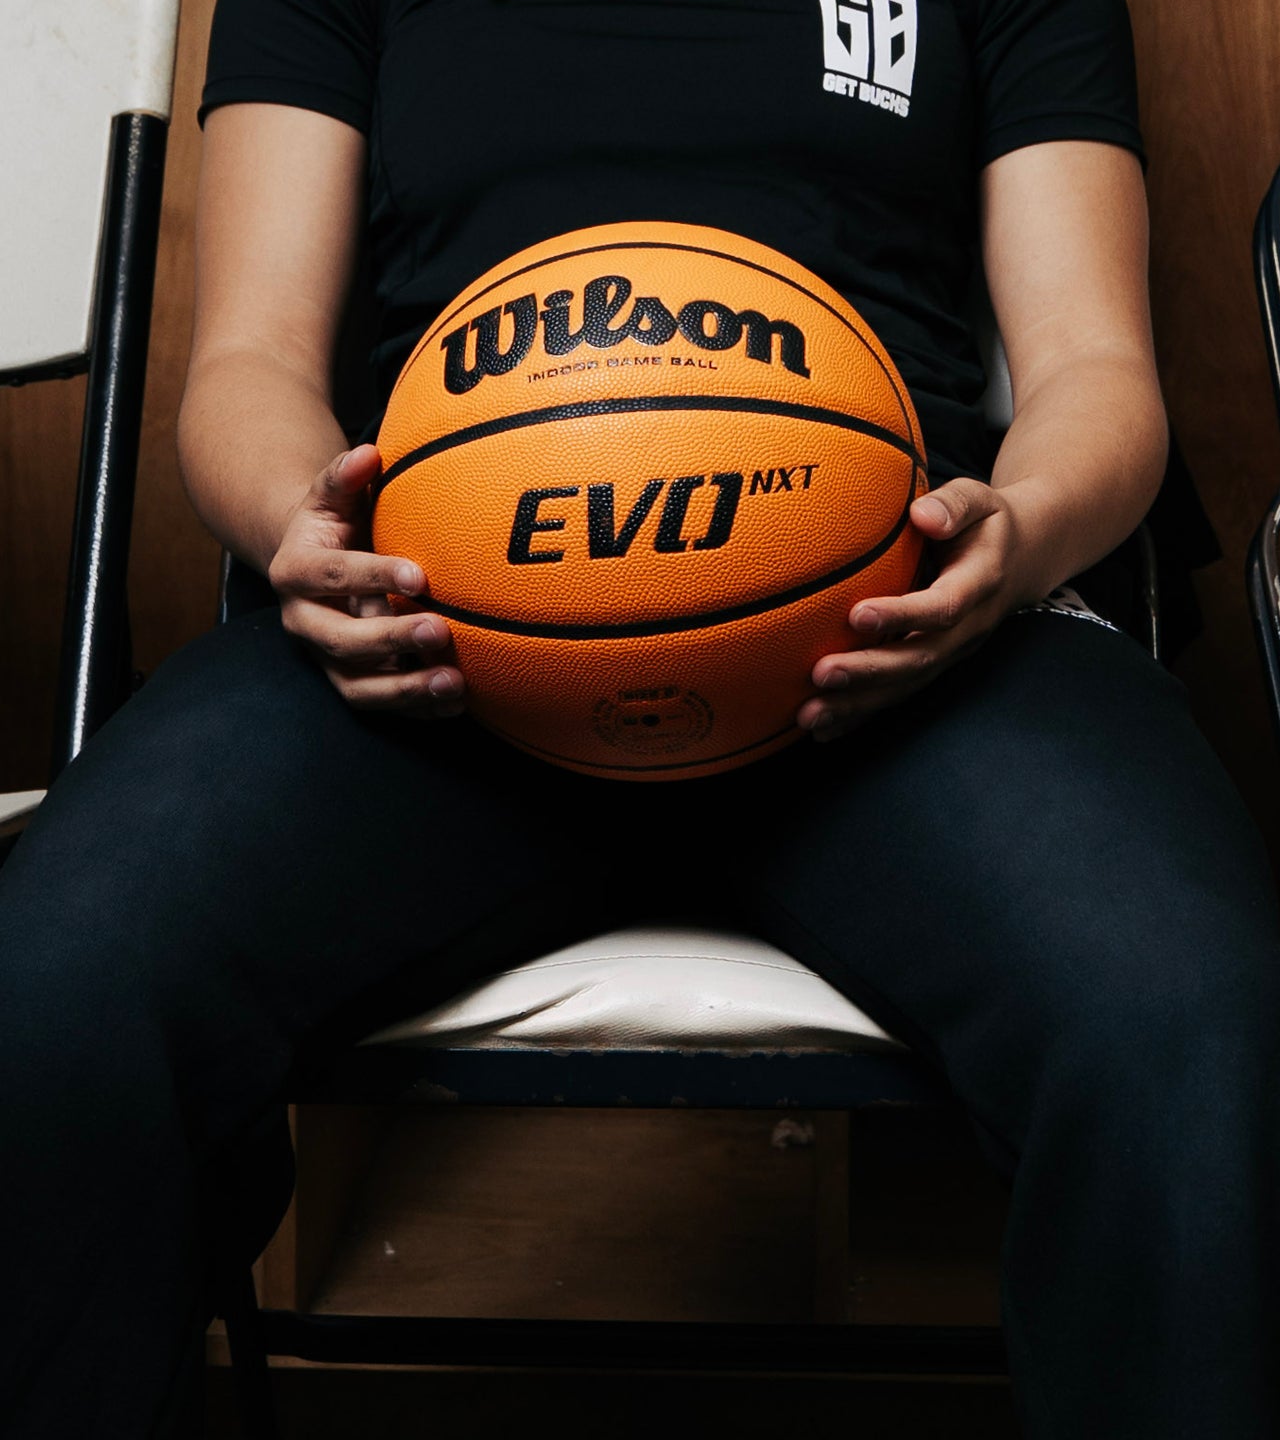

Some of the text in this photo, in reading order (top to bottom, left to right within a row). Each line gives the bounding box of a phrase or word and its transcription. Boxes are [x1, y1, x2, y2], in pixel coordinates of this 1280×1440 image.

[823, 72, 858, 98] GET
[440, 274, 812, 396] Wilson
[671, 357, 718, 370] BALL
[506, 463, 821, 566] EVO NXT
